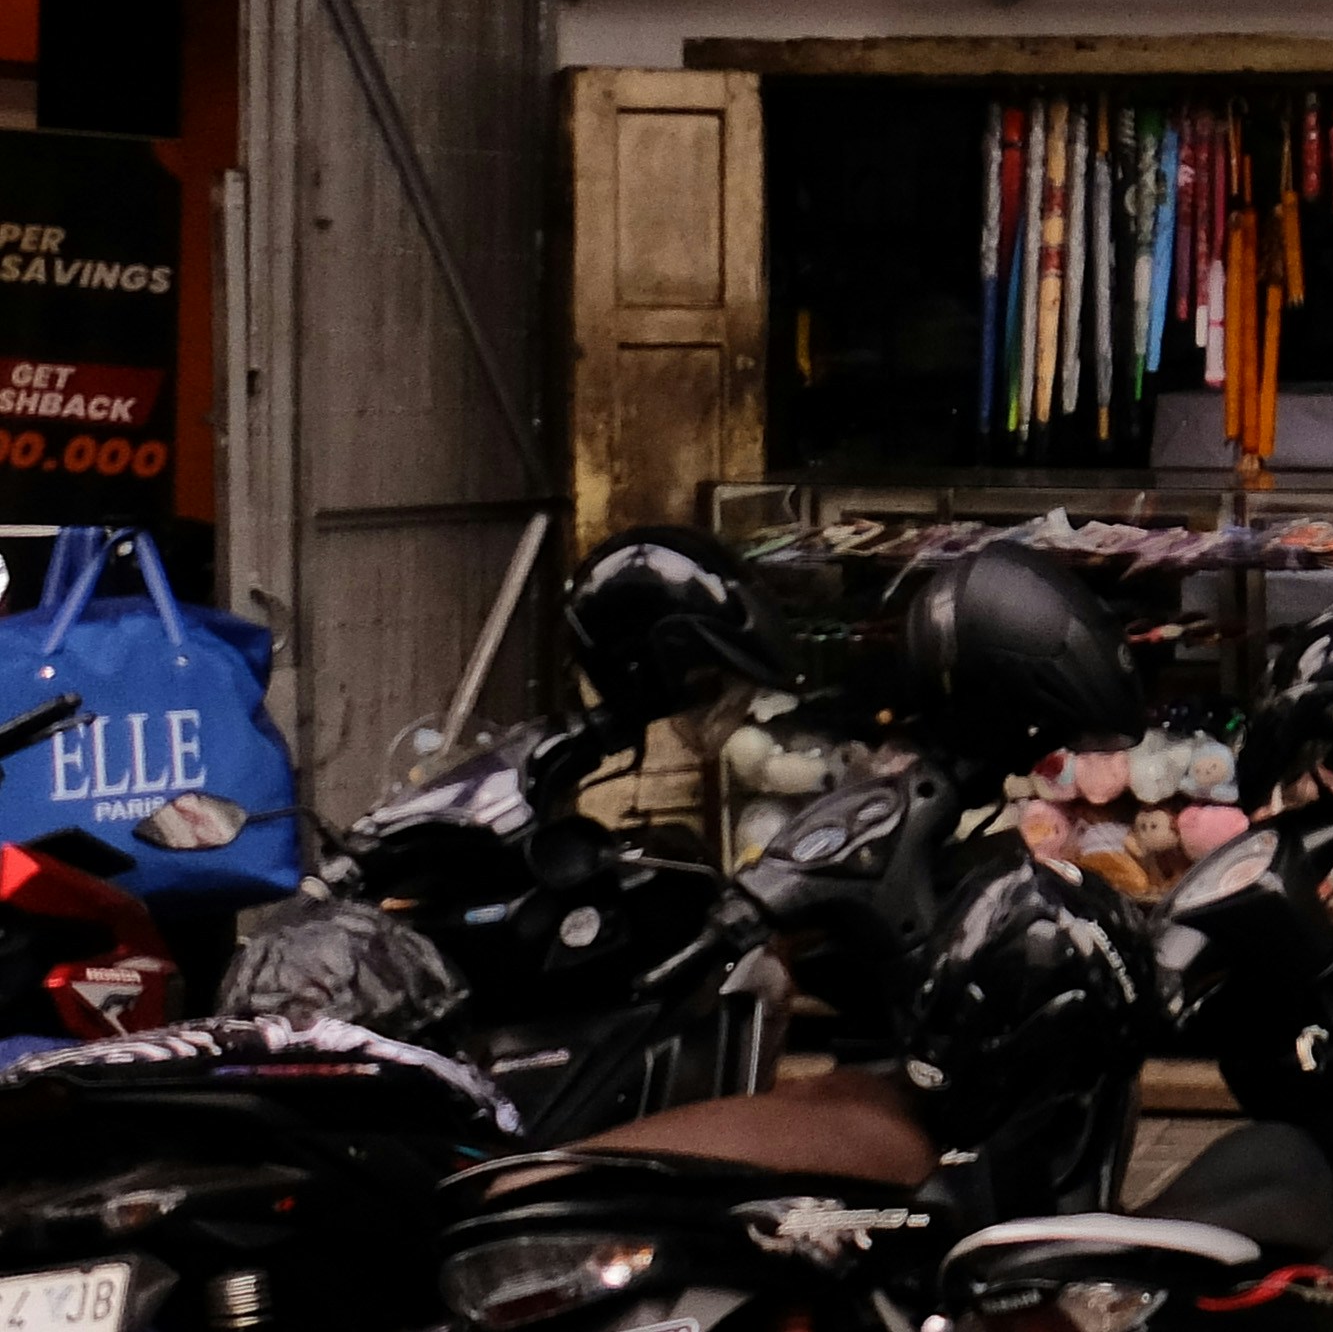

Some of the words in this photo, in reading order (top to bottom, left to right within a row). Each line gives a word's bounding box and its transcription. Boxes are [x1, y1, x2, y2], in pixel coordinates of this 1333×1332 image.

[0, 255, 172, 294] SAVINGS
[10, 361, 77, 390] GET
[52, 709, 206, 800] ELLE
